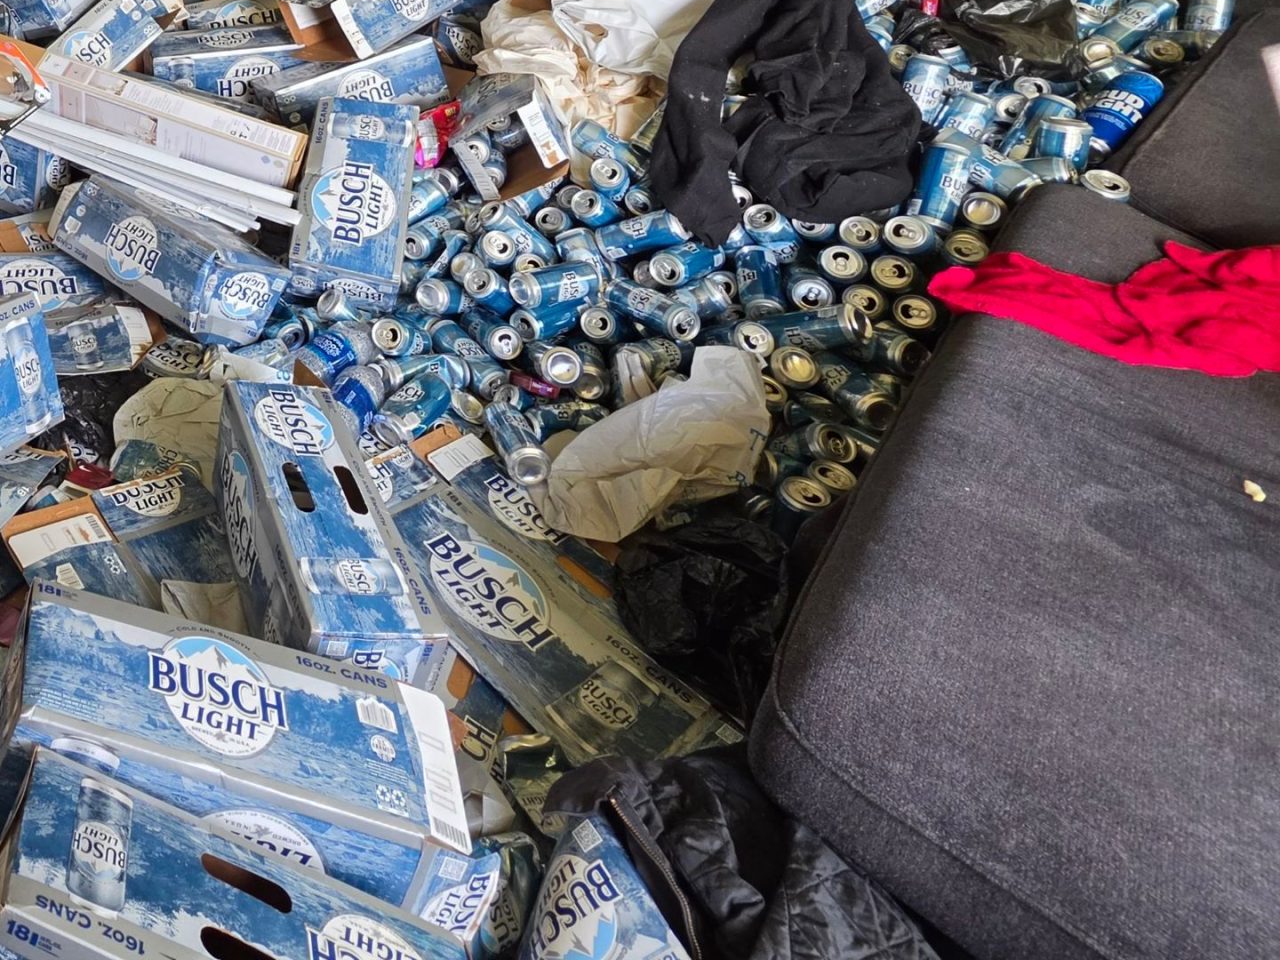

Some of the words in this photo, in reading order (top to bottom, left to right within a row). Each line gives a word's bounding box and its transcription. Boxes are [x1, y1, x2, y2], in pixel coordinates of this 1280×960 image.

[405, 0, 427, 17] LIGHT
[198, 31, 254, 44] BUSCH
[445, 26, 478, 52] BUSC
[233, 65, 274, 77] LIGHT
[344, 75, 377, 94] LIGHT
[903, 82, 941, 99] BUSC
[319, 100, 329, 123] CANS
[1100, 99, 1143, 123] GHT
[946, 118, 988, 140] BUSC
[942, 175, 968, 190] BUS
[333, 161, 373, 246] BUSCH
[364, 182, 384, 231] LIGHT
[125, 220, 156, 242] LIGHT
[105, 225, 161, 273] BUSCH
[5, 267, 54, 278] LIGHT
[236, 274, 266, 291] LIGHT
[12, 300, 36, 315] CANS
[220, 278, 271, 310] BUSCH
[148, 347, 191, 371] LIGHT
[263, 403, 288, 440] LIGHT
[272, 390, 321, 456] BUSCH
[136, 493, 176, 511] LIGHT
[492, 498, 535, 536] LIGHT
[341, 562, 356, 590] LIGHT
[408, 577, 432, 616] CANS
[423, 533, 557, 650] BUSCH
[435, 567, 508, 633] LIGHT
[151, 654, 287, 728] BUSCH
[340, 666, 389, 691] CANS
[645, 664, 693, 704] CANS
[581, 678, 638, 729] BUSCH
[582, 692, 619, 727] LIGHT
[181, 702, 260, 739] LIGHT
[72, 831, 127, 869] BUSCH
[82, 826, 119, 847] LIGHT
[35, 894, 93, 930] CANS
[529, 861, 620, 959] BUSCH
